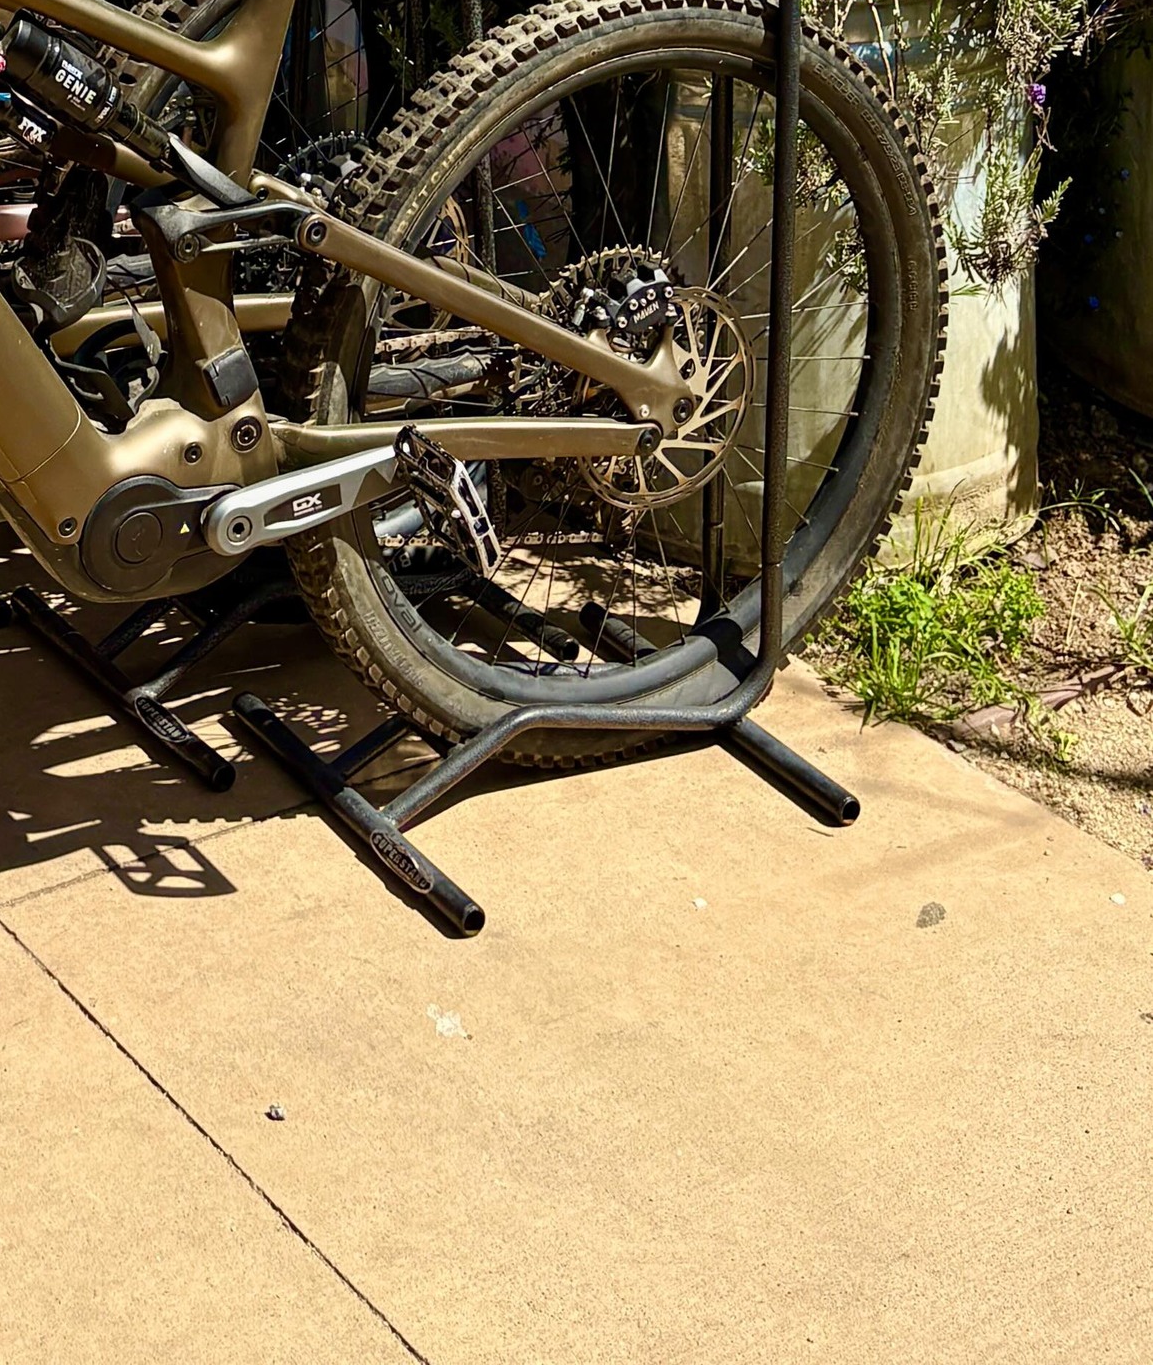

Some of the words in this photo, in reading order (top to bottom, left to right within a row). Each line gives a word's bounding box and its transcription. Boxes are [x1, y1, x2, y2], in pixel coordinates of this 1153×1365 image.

[55, 69, 97, 105] GENIE
[17, 116, 47, 144] FOX
[633, 300, 659, 324] MAVEN
[292, 492, 322, 512] GX
[372, 834, 427, 888] SUPERSTAND
